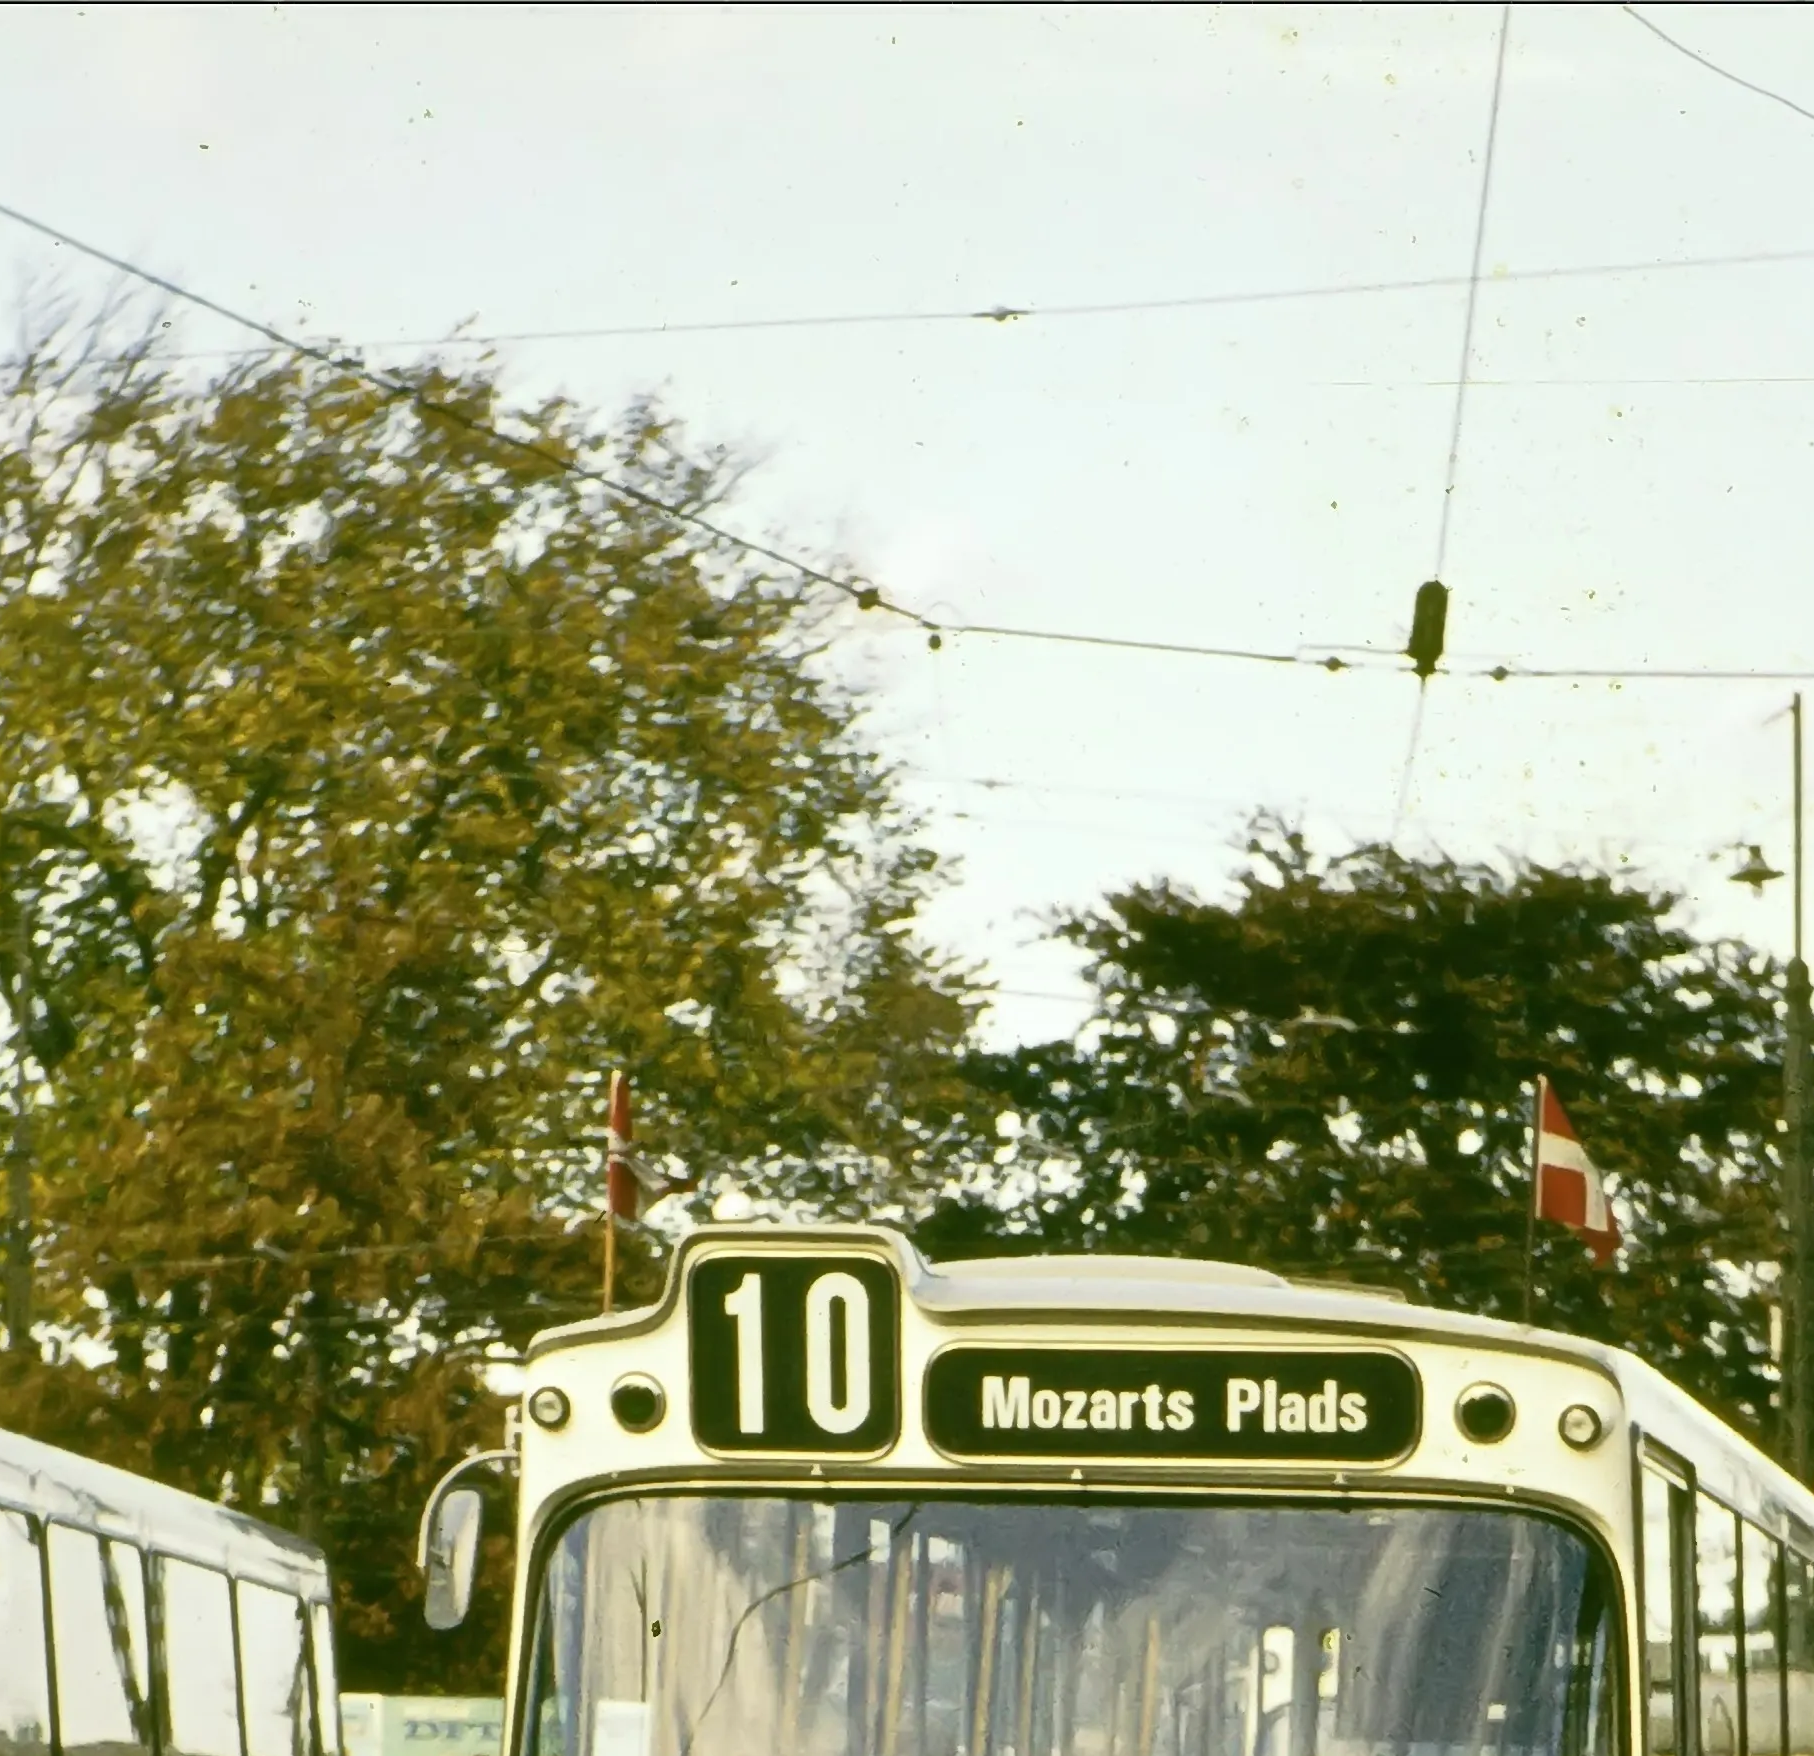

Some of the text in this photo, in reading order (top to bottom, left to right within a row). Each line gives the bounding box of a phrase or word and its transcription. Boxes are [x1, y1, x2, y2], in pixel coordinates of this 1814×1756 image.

[723, 1271, 870, 1435] 10
[981, 1375, 1368, 1434] Mozarts Plads
